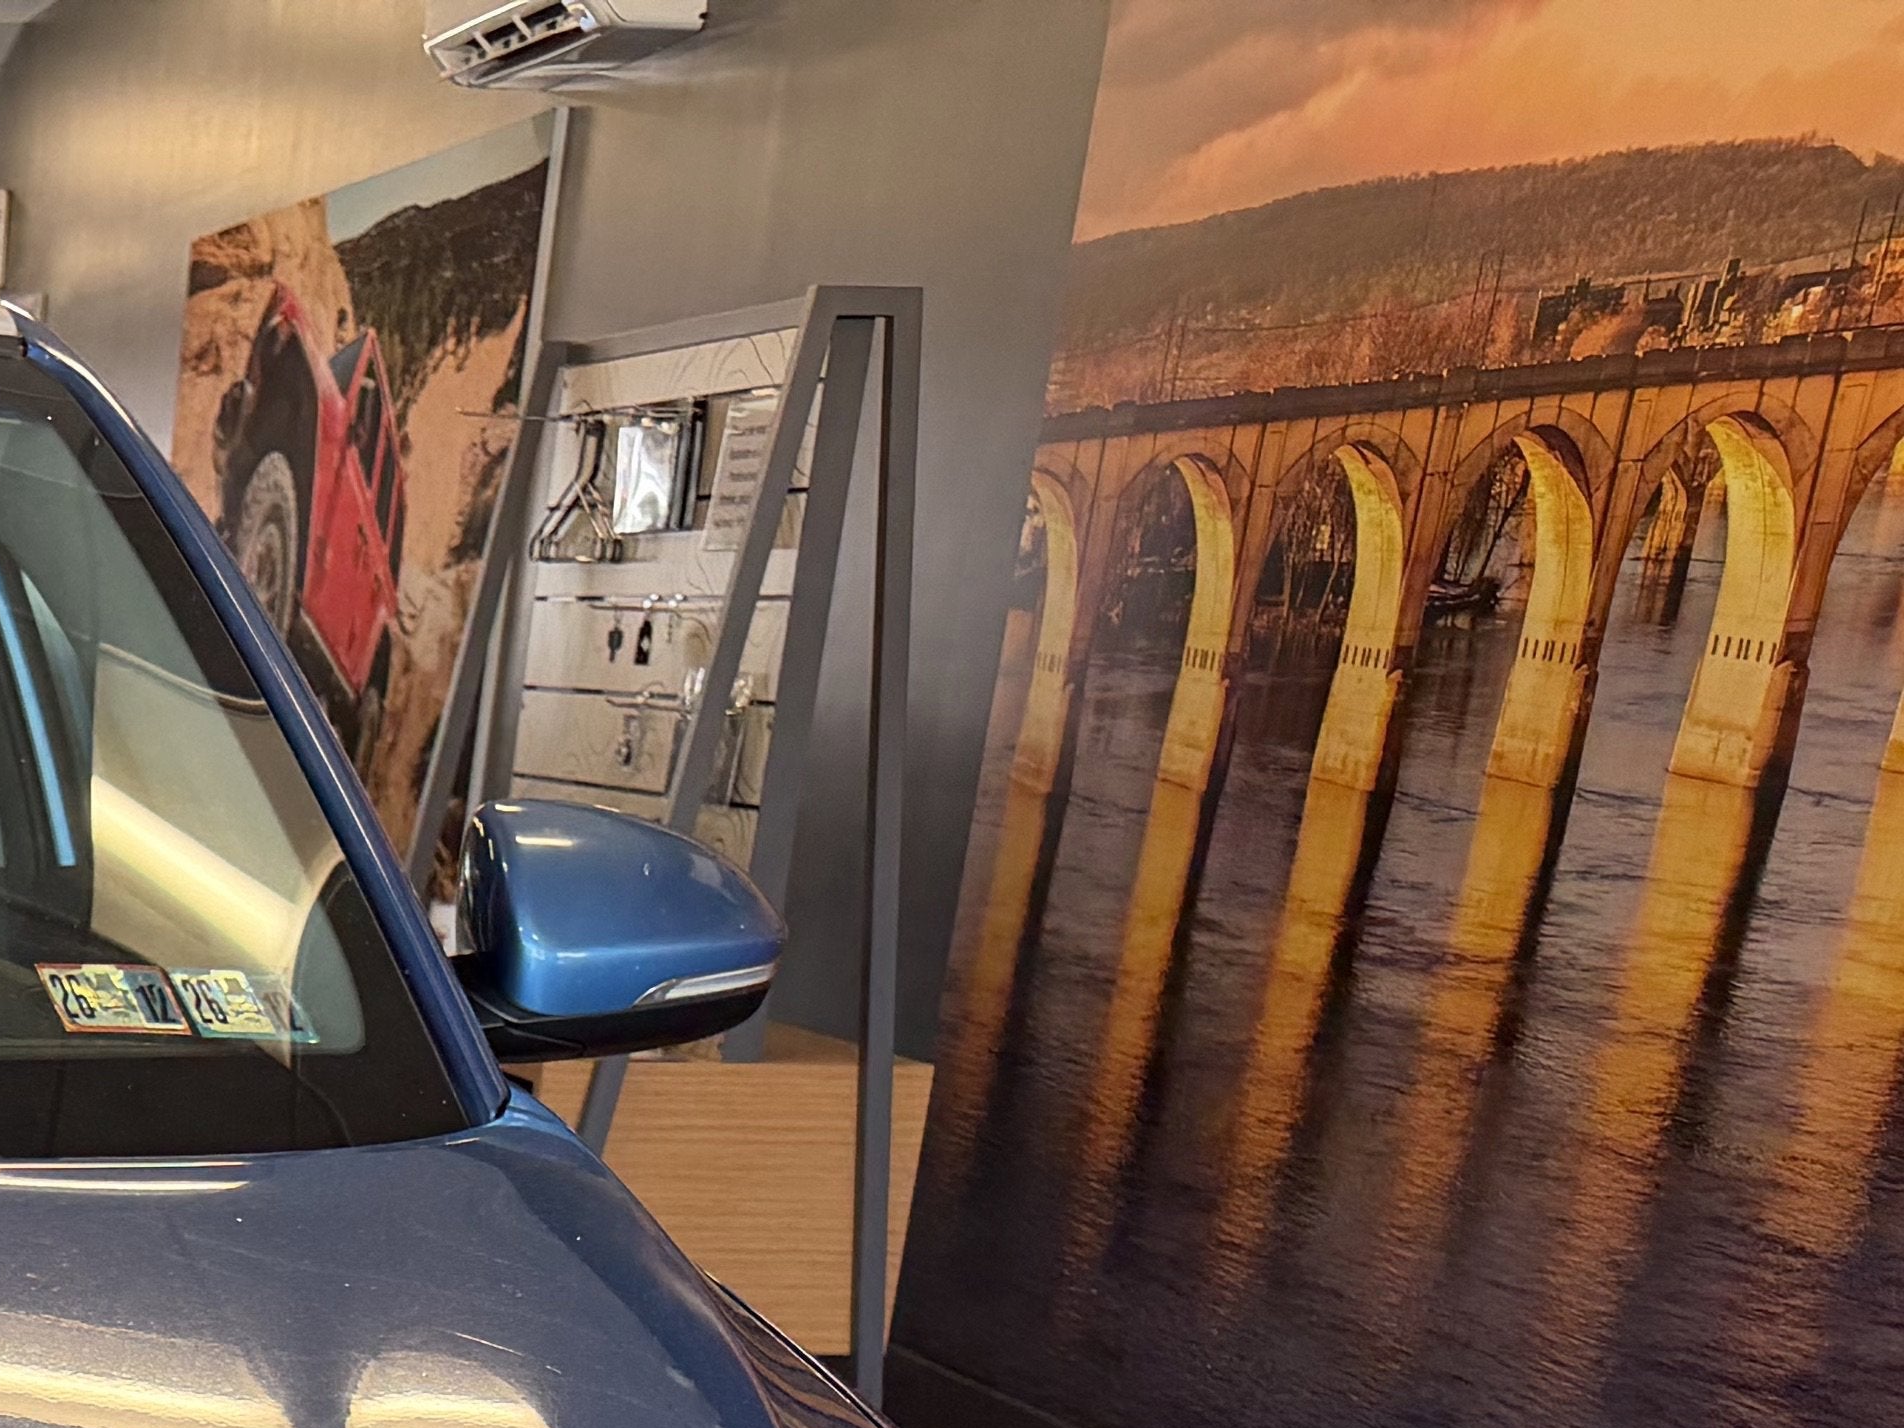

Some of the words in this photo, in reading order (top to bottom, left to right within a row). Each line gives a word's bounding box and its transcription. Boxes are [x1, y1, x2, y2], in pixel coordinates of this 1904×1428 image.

[49, 974, 96, 1019] 26
[135, 984, 177, 1023] 12
[181, 978, 229, 1025] 26
